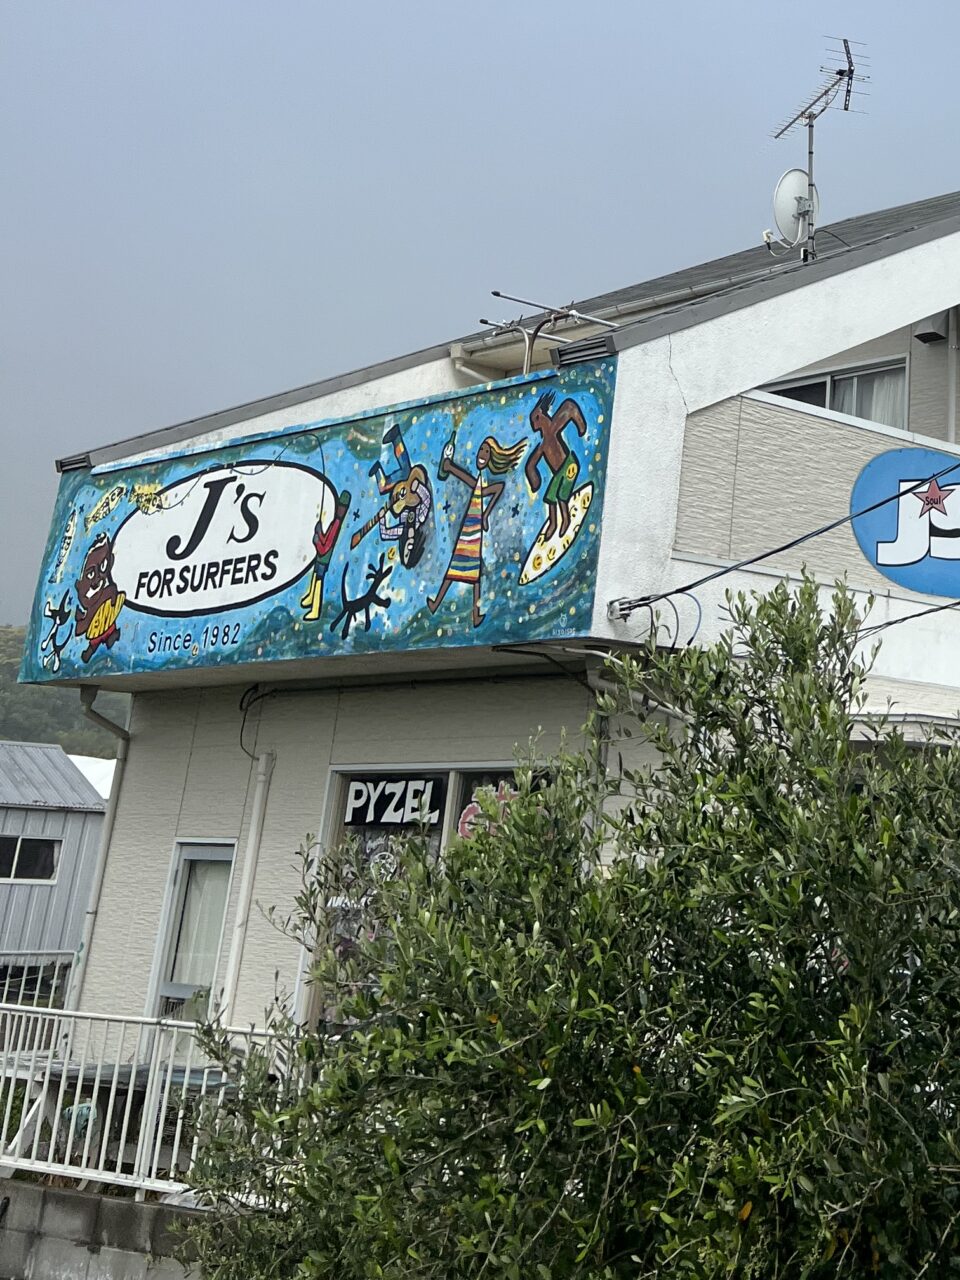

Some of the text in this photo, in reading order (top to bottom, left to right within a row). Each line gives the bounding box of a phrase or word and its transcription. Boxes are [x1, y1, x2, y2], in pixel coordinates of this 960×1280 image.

[925, 495, 941, 506] Soul
[148, 623, 240, 653] Since 1982
[345, 780, 440, 823] PYZEL
